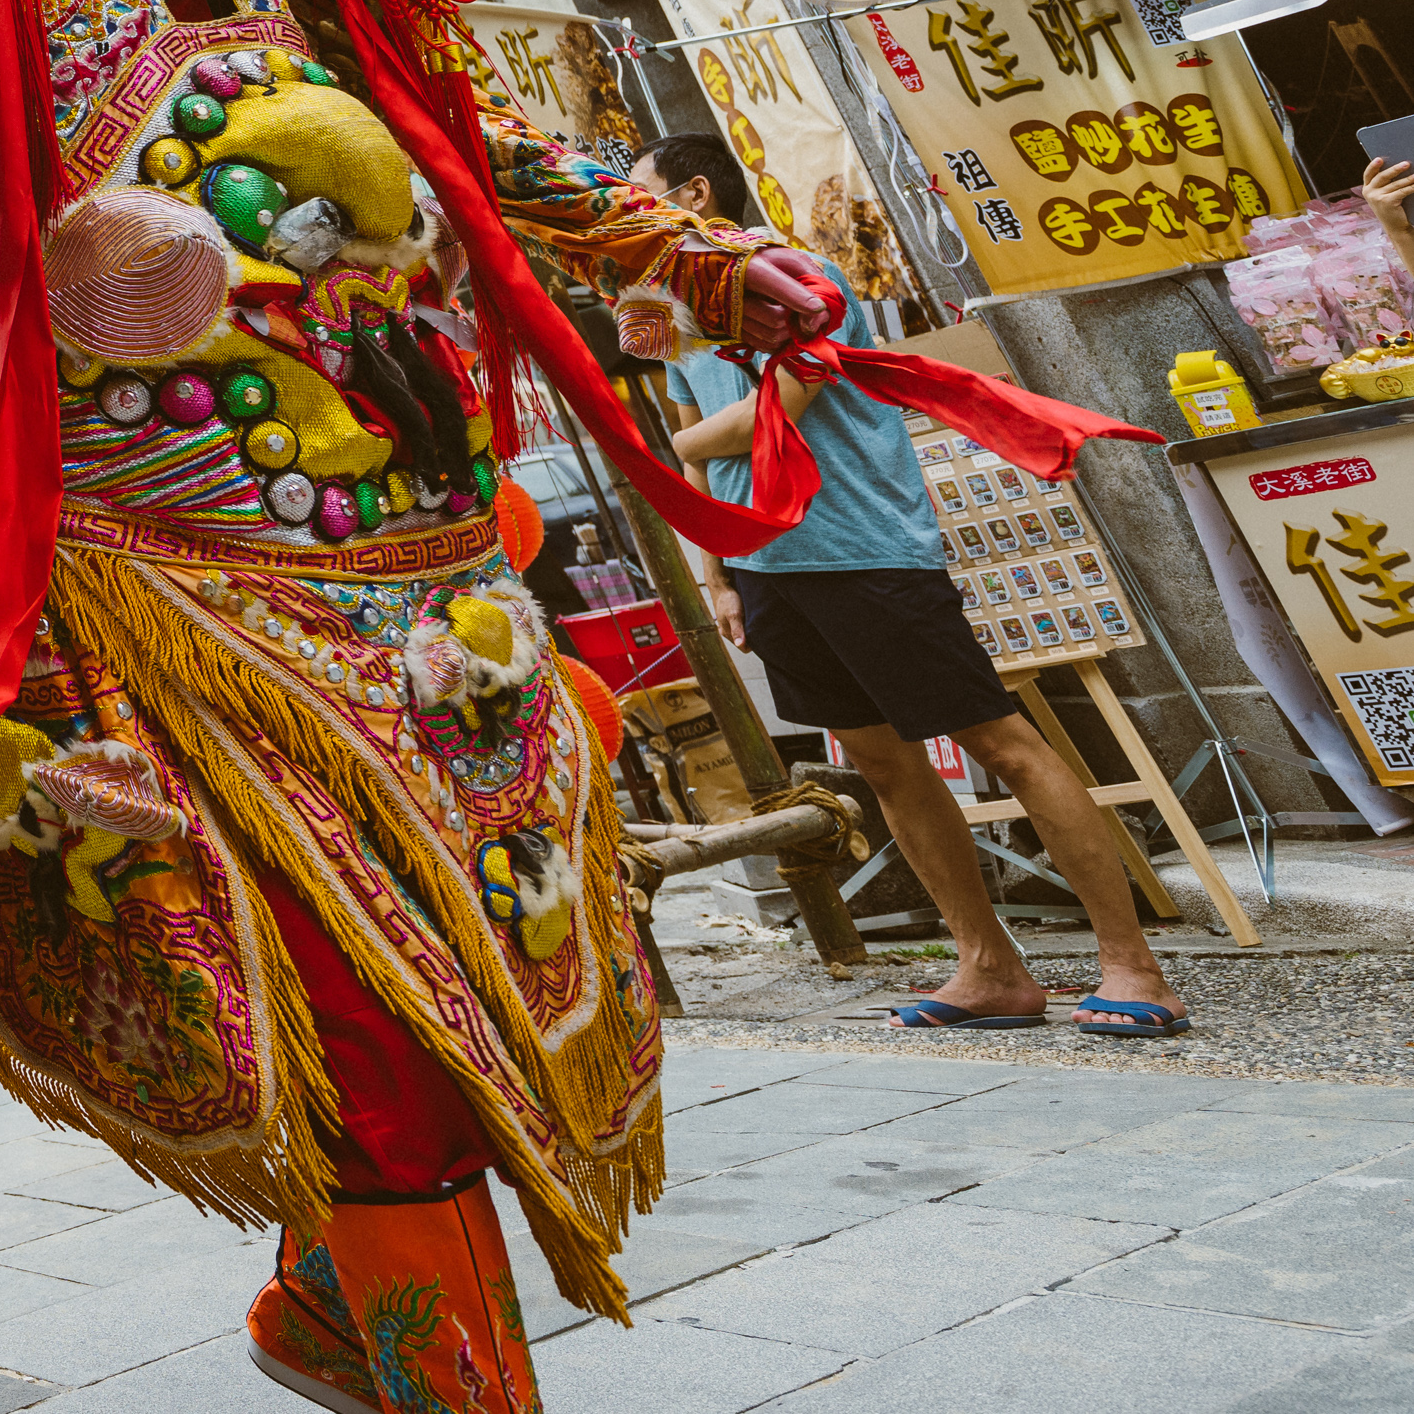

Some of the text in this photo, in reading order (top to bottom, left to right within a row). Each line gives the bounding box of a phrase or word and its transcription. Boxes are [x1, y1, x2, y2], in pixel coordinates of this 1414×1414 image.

[1015, 103, 1221, 174] 鹽炒花生
[942, 148, 1025, 245] 祖傳
[1045, 172, 1266, 249] 手工花生糖
[1259, 461, 1373, 497] 大溪老街
